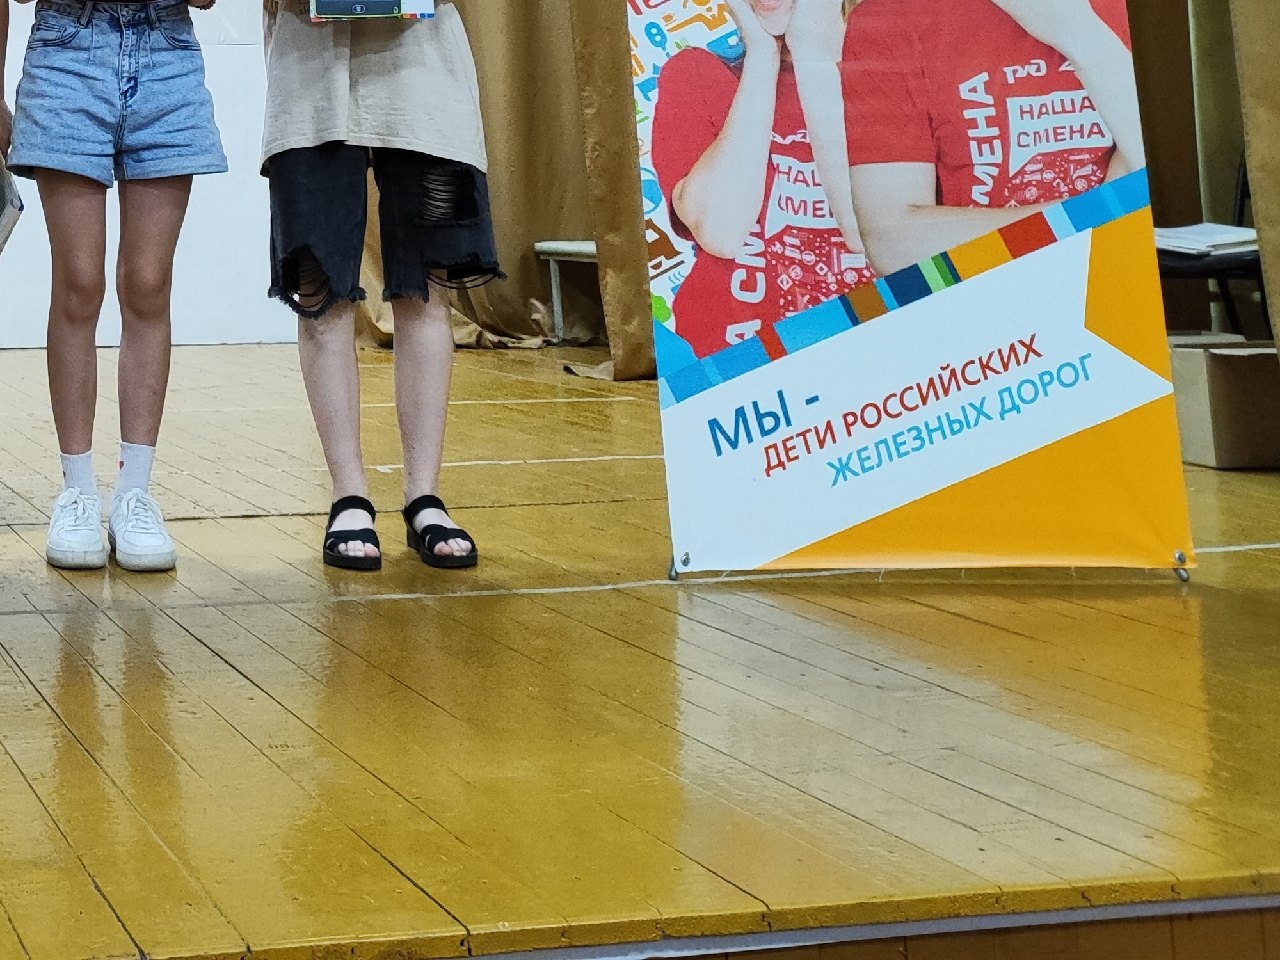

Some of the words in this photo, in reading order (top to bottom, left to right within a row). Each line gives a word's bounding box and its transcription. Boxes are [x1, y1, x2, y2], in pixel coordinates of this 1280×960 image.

[959, 71, 1003, 206] МЕНА
[1016, 122, 1106, 148] СМЕНА
[1019, 96, 1097, 121] НАША
[707, 388, 792, 457] МЫ
[764, 419, 837, 478] ДЕТИ
[843, 332, 1043, 438] РОССИЙСКИХ
[826, 402, 994, 487] ЖЕЛЕЗНЫХ
[998, 352, 1093, 421] ДОРОГ
